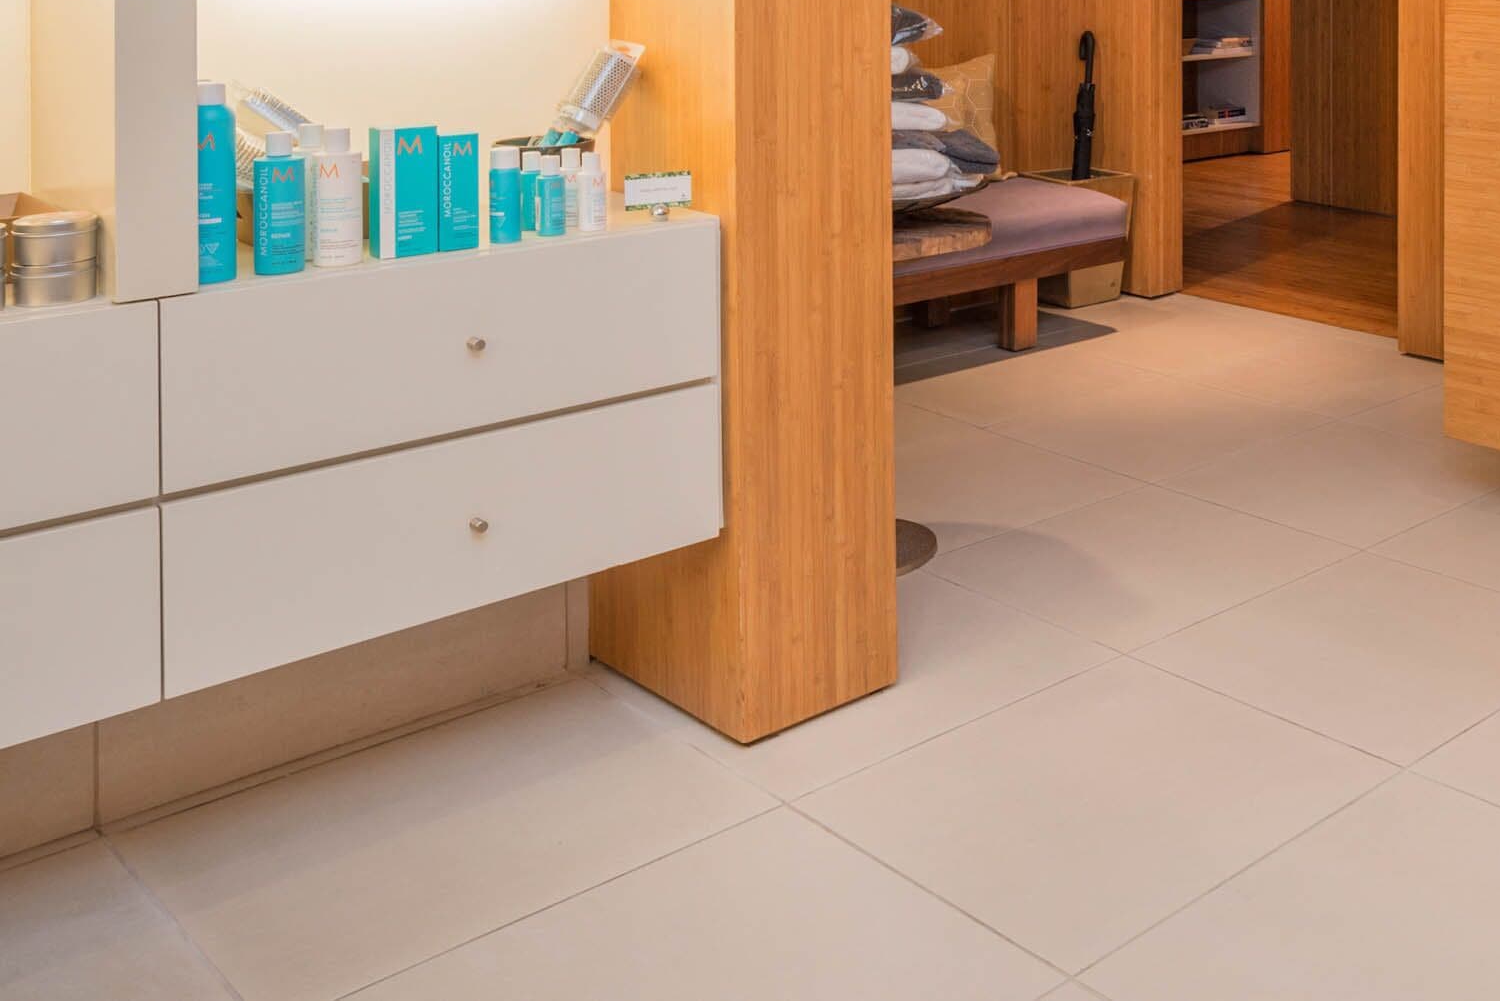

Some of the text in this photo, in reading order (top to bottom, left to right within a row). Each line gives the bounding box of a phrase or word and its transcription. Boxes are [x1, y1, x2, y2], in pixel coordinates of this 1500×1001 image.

[397, 135, 423, 156] M
[453, 141, 472, 157] M
[272, 167, 295, 183] M
[320, 163, 340, 178] M
[443, 142, 452, 218] MOROCCANOIL
[259, 167, 269, 256] MOROCCANOIL
